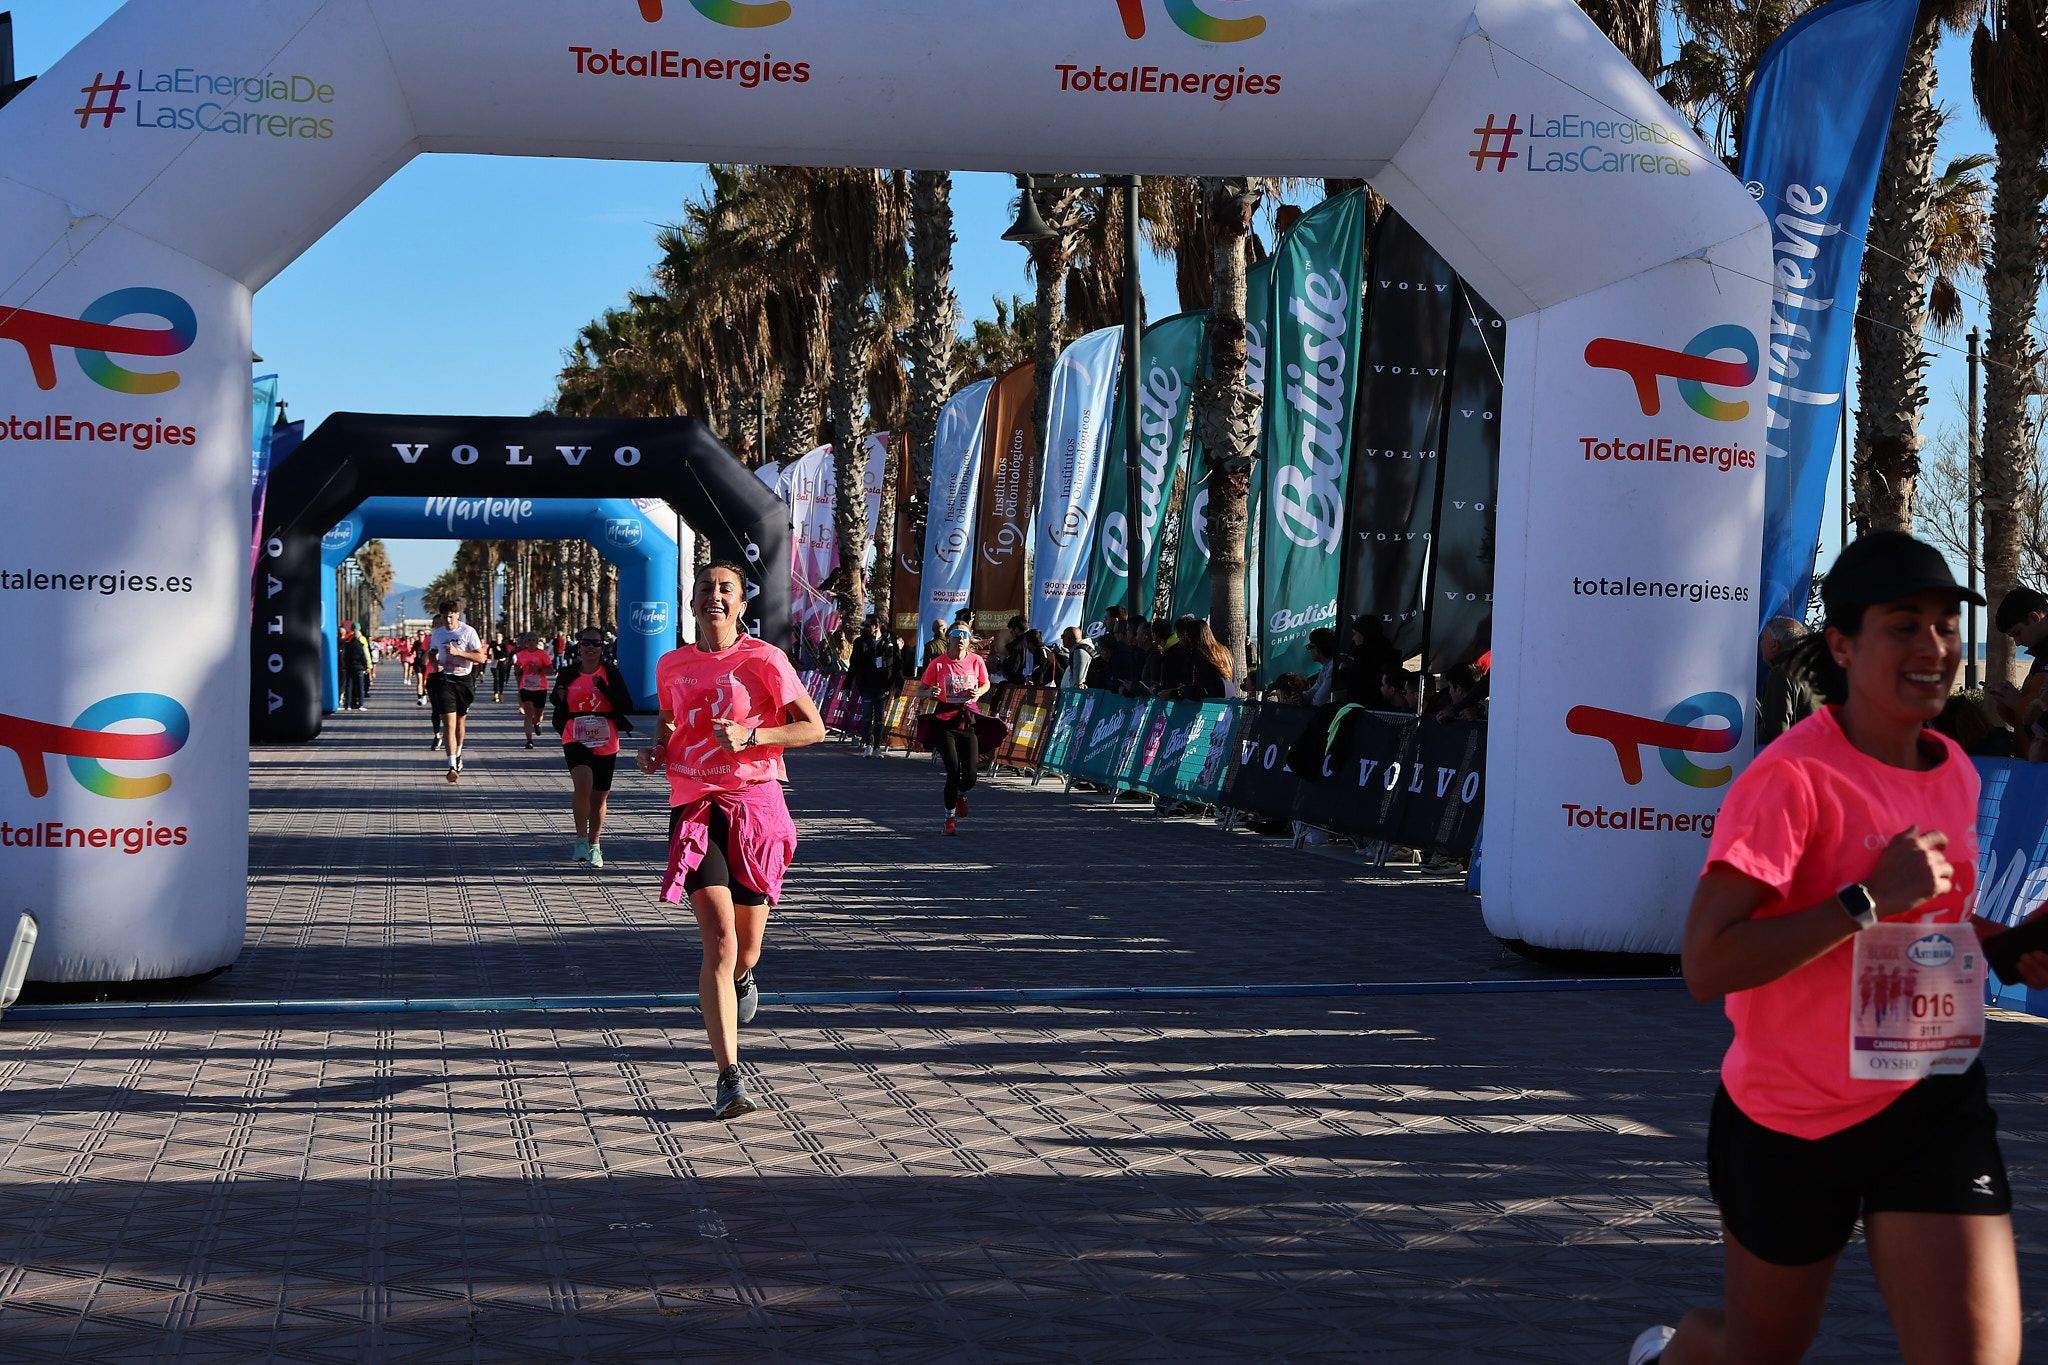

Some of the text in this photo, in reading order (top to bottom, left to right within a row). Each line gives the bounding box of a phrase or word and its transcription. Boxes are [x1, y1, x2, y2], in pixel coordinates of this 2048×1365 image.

[569, 46, 811, 88] TotalEnergies
[1055, 64, 1282, 101] TotalEnergies
[136, 101, 334, 140] LasCarreras
[1527, 145, 1691, 177] LasCarreras
[1380, 280, 1448, 292] VOLV
[1274, 267, 1348, 556] Batiste
[0, 415, 196, 451] otalEnergies
[391, 443, 642, 467] VOLVO
[1060, 437, 1076, 499] Institutos
[1073, 409, 1091, 500] Odontológicos
[1366, 449, 1436, 459] VOLVO
[1579, 437, 1756, 472] TotalEnergies
[992, 457, 1008, 517] Institutos
[1006, 427, 1025, 518] Odontológicos
[424, 496, 534, 532] Marlene
[945, 472, 958, 523] Institutos
[1359, 532, 1431, 541] VOLVO
[0, 568, 193, 595] talenergies.es
[745, 543, 761, 637] LVO
[1044, 581, 1060, 589] 900
[1445, 592, 1494, 602] VOL
[1573, 576, 1749, 603] totalenergies.es
[266, 537, 285, 715] VOLVO
[632, 609, 666, 627] Marlene
[1270, 599, 1337, 633] Batist
[1350, 610, 1417, 622] VLVO
[1359, 757, 1480, 804] VOLVO
[0, 819, 188, 855] talEnergies
[1562, 804, 1722, 838] TotalEnerg
[1911, 994, 1954, 1018] 016
[1870, 1056, 1918, 1070] OYSHO
